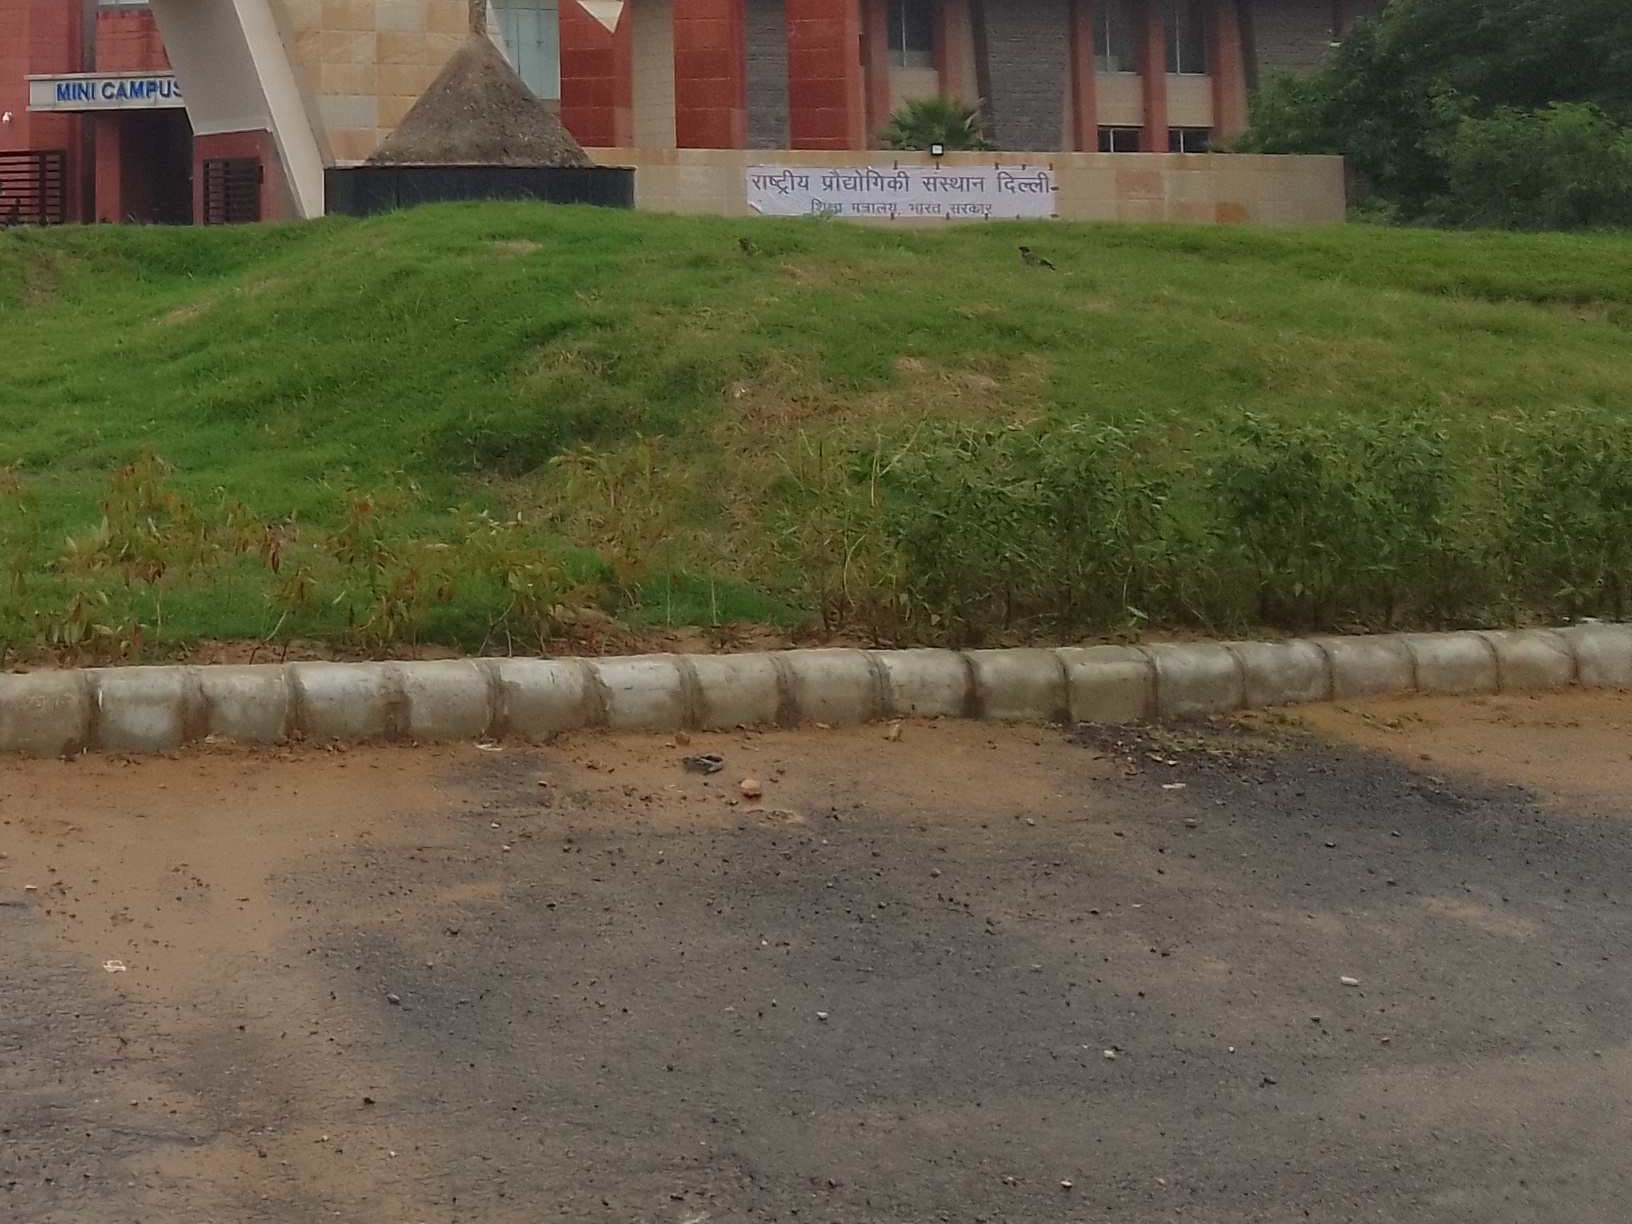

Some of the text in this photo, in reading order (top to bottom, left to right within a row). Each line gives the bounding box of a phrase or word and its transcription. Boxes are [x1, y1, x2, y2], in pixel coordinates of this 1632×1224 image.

[56, 82, 96, 102] MINI
[751, 169, 1051, 195] राष्ट्रीय प्रौद्योगिकी संस्थान दिल्ली
[909, 202, 942, 215] भारत
[950, 202, 993, 216] सरकार
